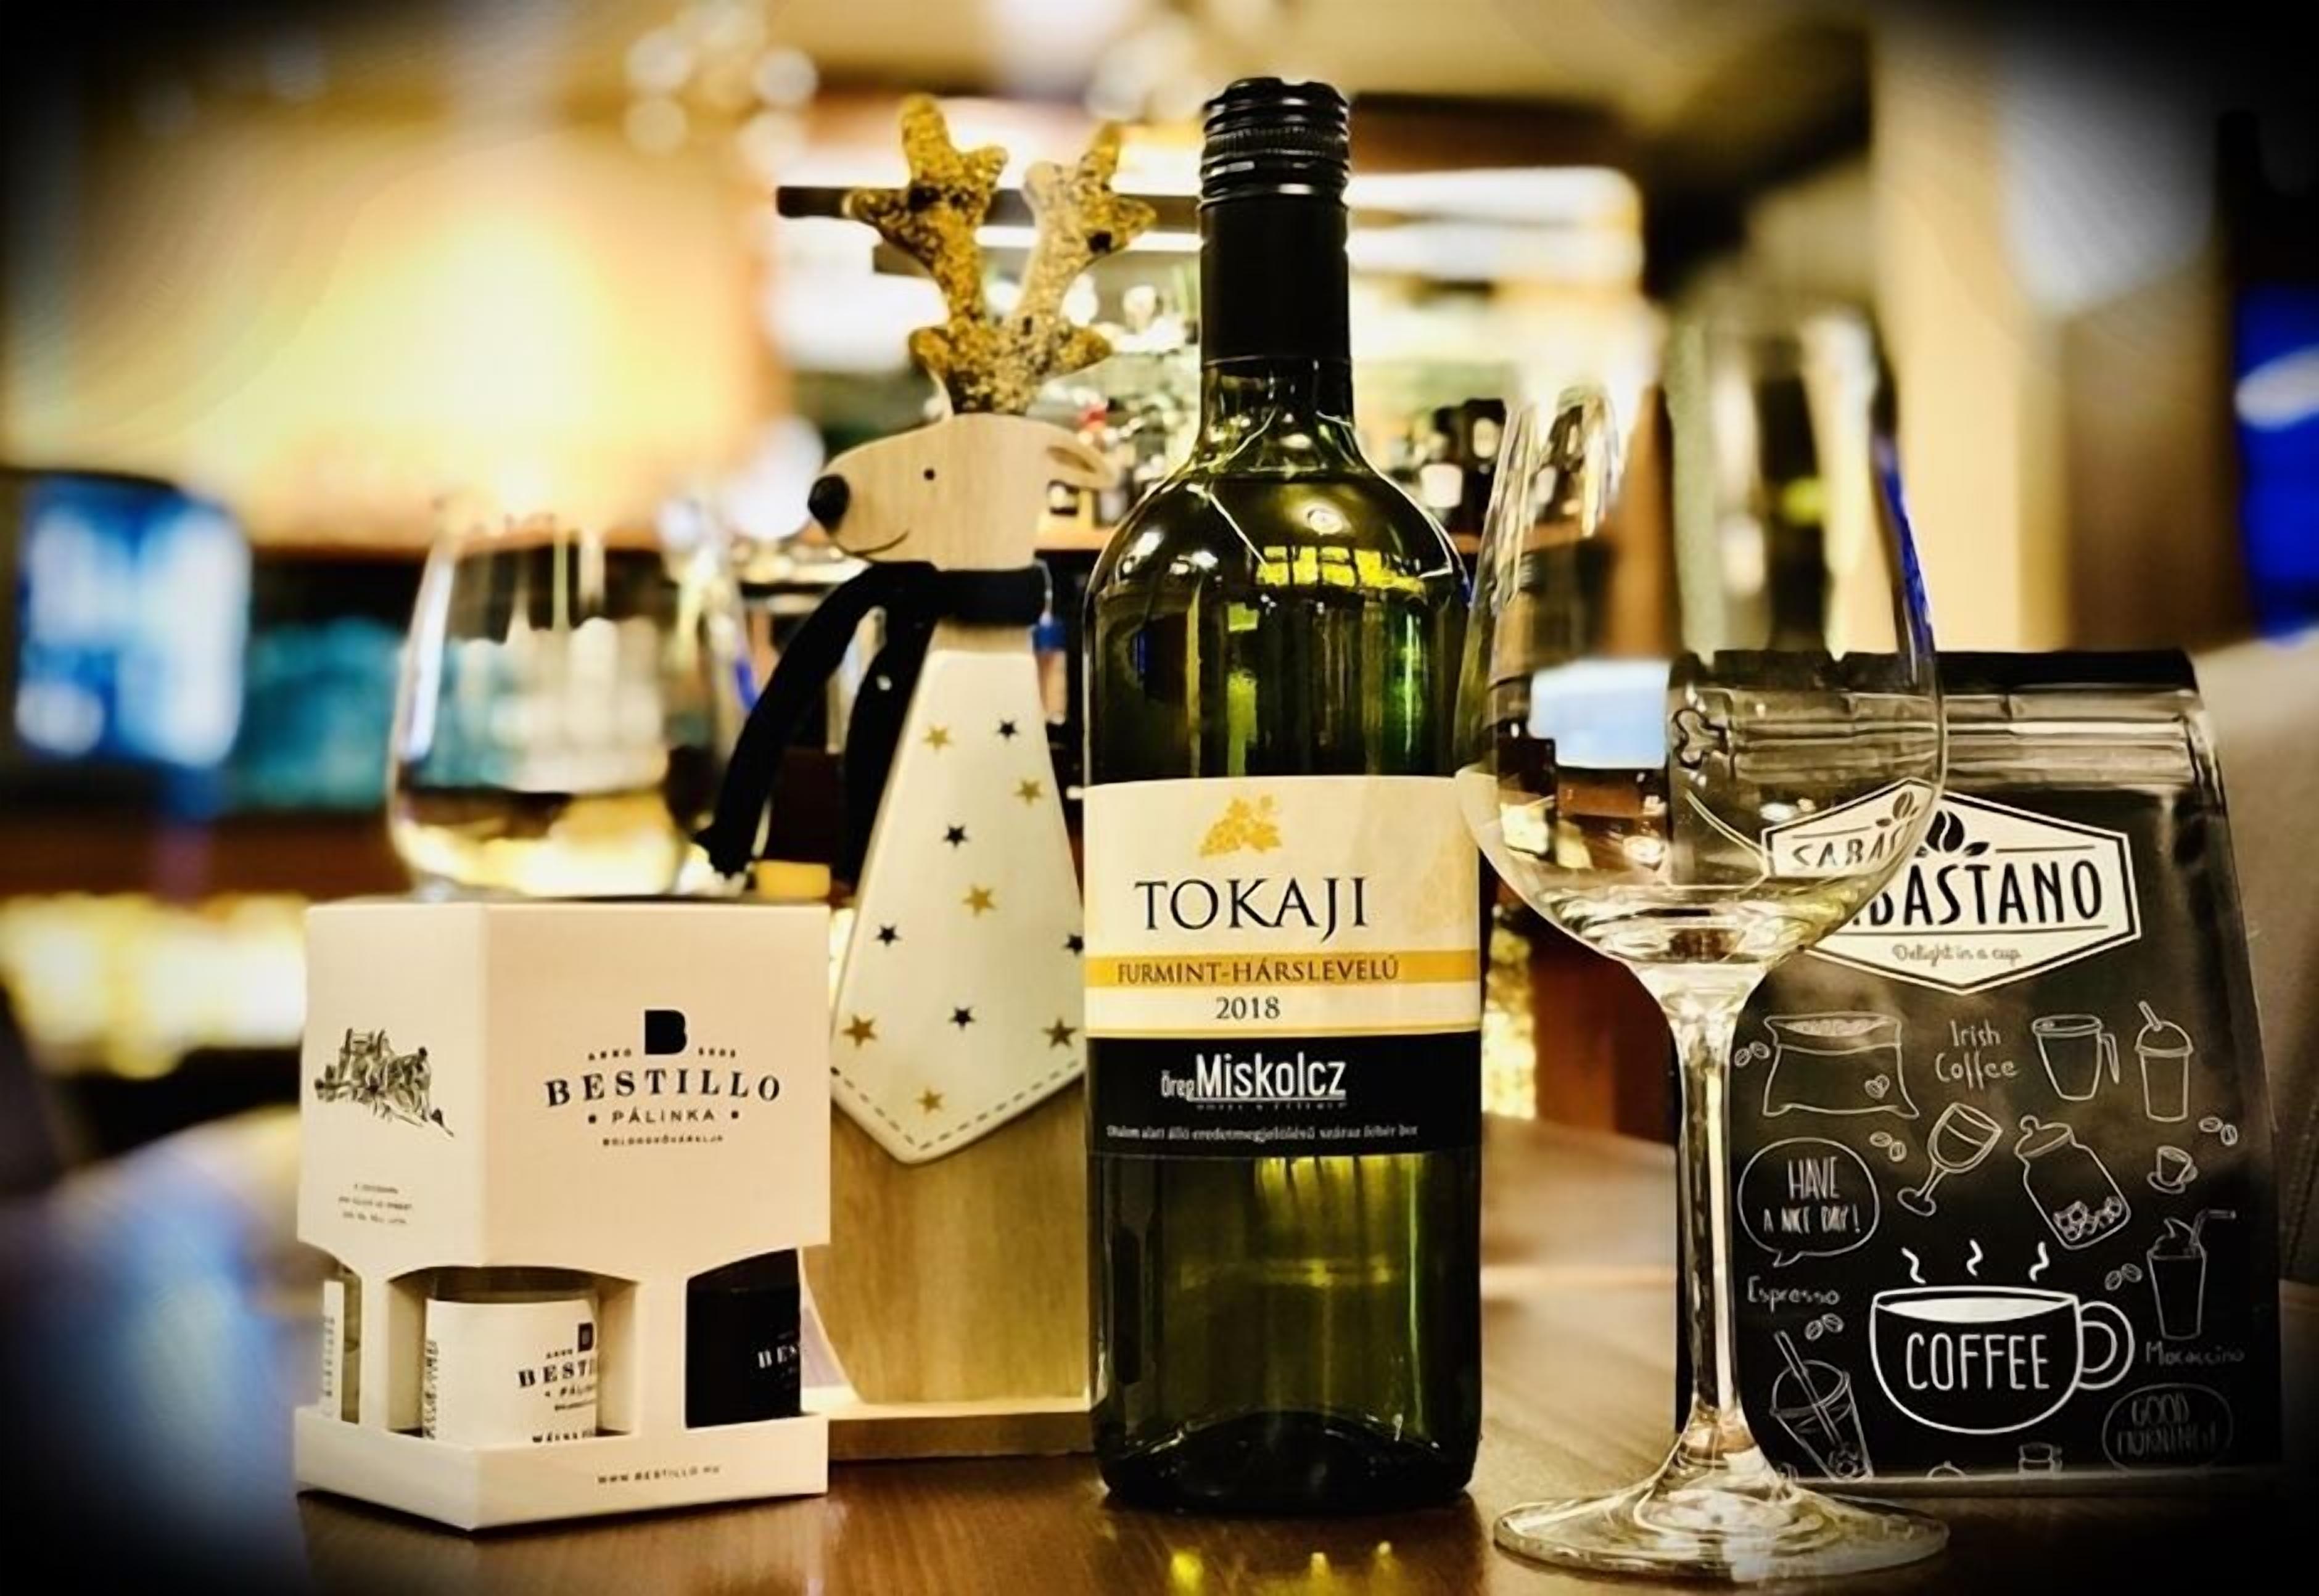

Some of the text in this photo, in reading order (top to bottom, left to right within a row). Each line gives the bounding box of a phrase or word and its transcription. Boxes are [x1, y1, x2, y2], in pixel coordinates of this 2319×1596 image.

[1135, 877, 1368, 942] TOKAJI
[1852, 860, 2103, 926] BASTANO
[1118, 957, 1399, 984] FURMINT-HÁRSLEVELŰ
[1992, 949, 2022, 966] cup
[1216, 997, 1281, 1019] 2018
[644, 1009, 688, 1055] B
[1950, 1019, 2001, 1047] Irish
[544, 1067, 780, 1108] BESTILLO
[1195, 1051, 1346, 1097] Miskolcz
[1935, 1050, 2019, 1090] Coffee
[611, 1106, 716, 1124] PÁLINKA
[1787, 1156, 1840, 1200] HAVE
[1747, 1275, 1840, 1313] Espresso
[1906, 1332, 2050, 1391] COFFEE
